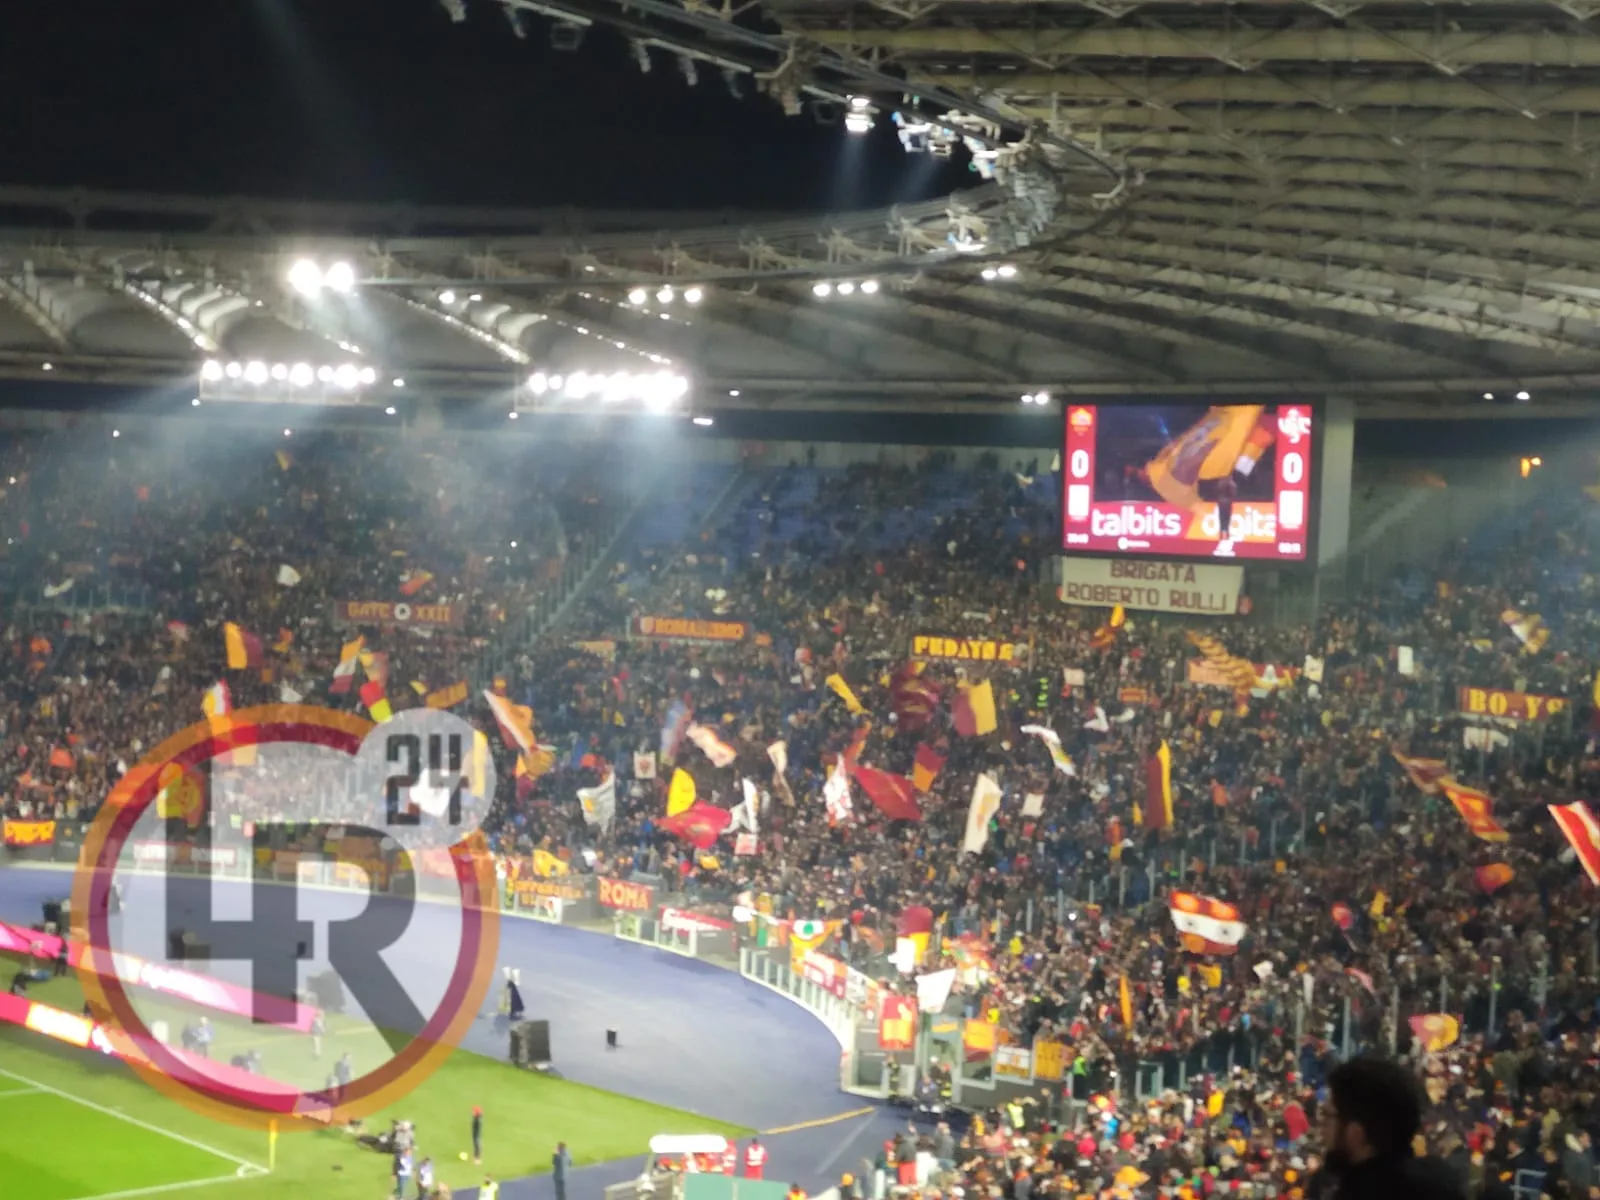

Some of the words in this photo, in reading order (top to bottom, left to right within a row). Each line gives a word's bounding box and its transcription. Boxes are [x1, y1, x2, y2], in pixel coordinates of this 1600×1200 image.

[1071, 449, 1089, 478] 0
[1282, 453, 1303, 483] 0
[1092, 505, 1181, 536] talbits
[1202, 503, 1275, 541] dgita
[1110, 560, 1196, 583] BRIGATA
[1066, 583, 1160, 606] ROBERTO
[1170, 590, 1227, 611] RULLI
[599, 878, 649, 910] ROMA
